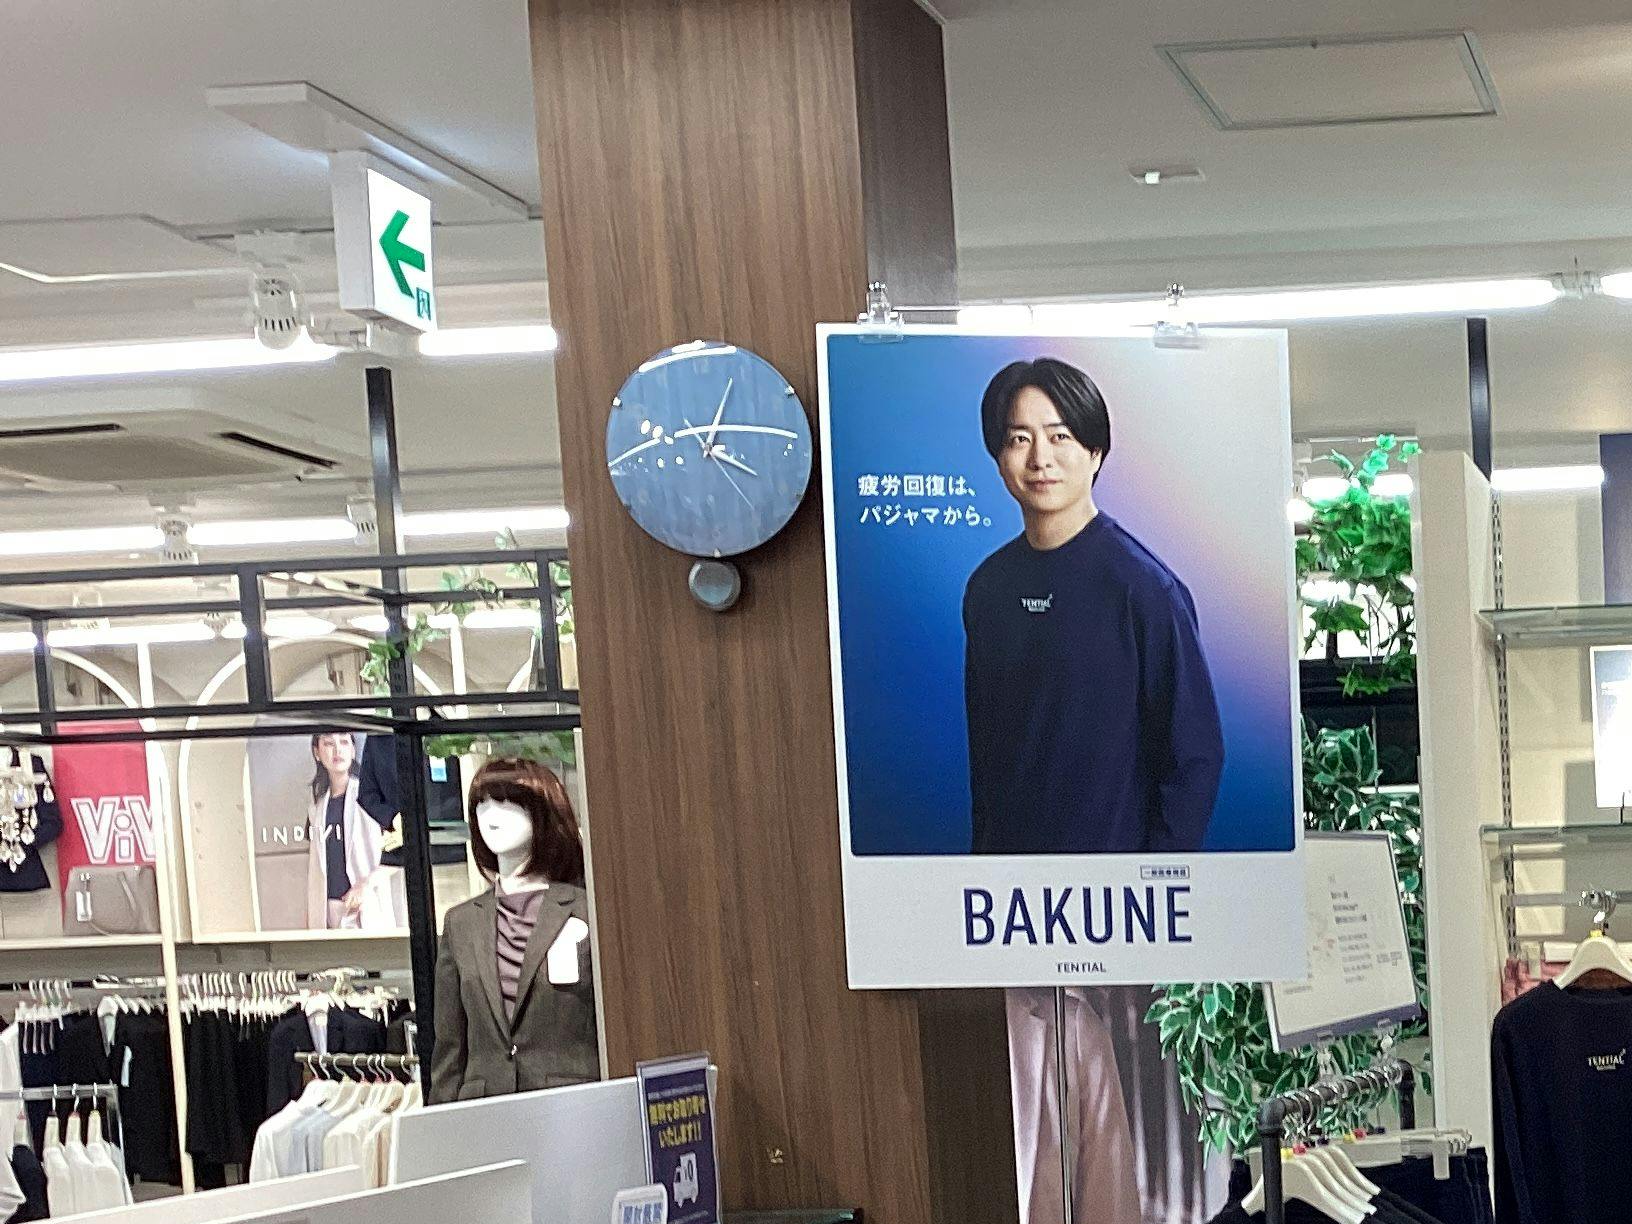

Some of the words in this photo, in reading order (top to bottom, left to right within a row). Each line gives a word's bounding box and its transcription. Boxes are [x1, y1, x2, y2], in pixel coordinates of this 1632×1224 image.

[857, 474, 977, 497] 疲労回復は、
[859, 504, 993, 528] パジャマから。
[262, 823, 342, 846] INDIVI
[963, 885, 1193, 947] BAKUNE
[1056, 961, 1107, 974] TENTIAL
